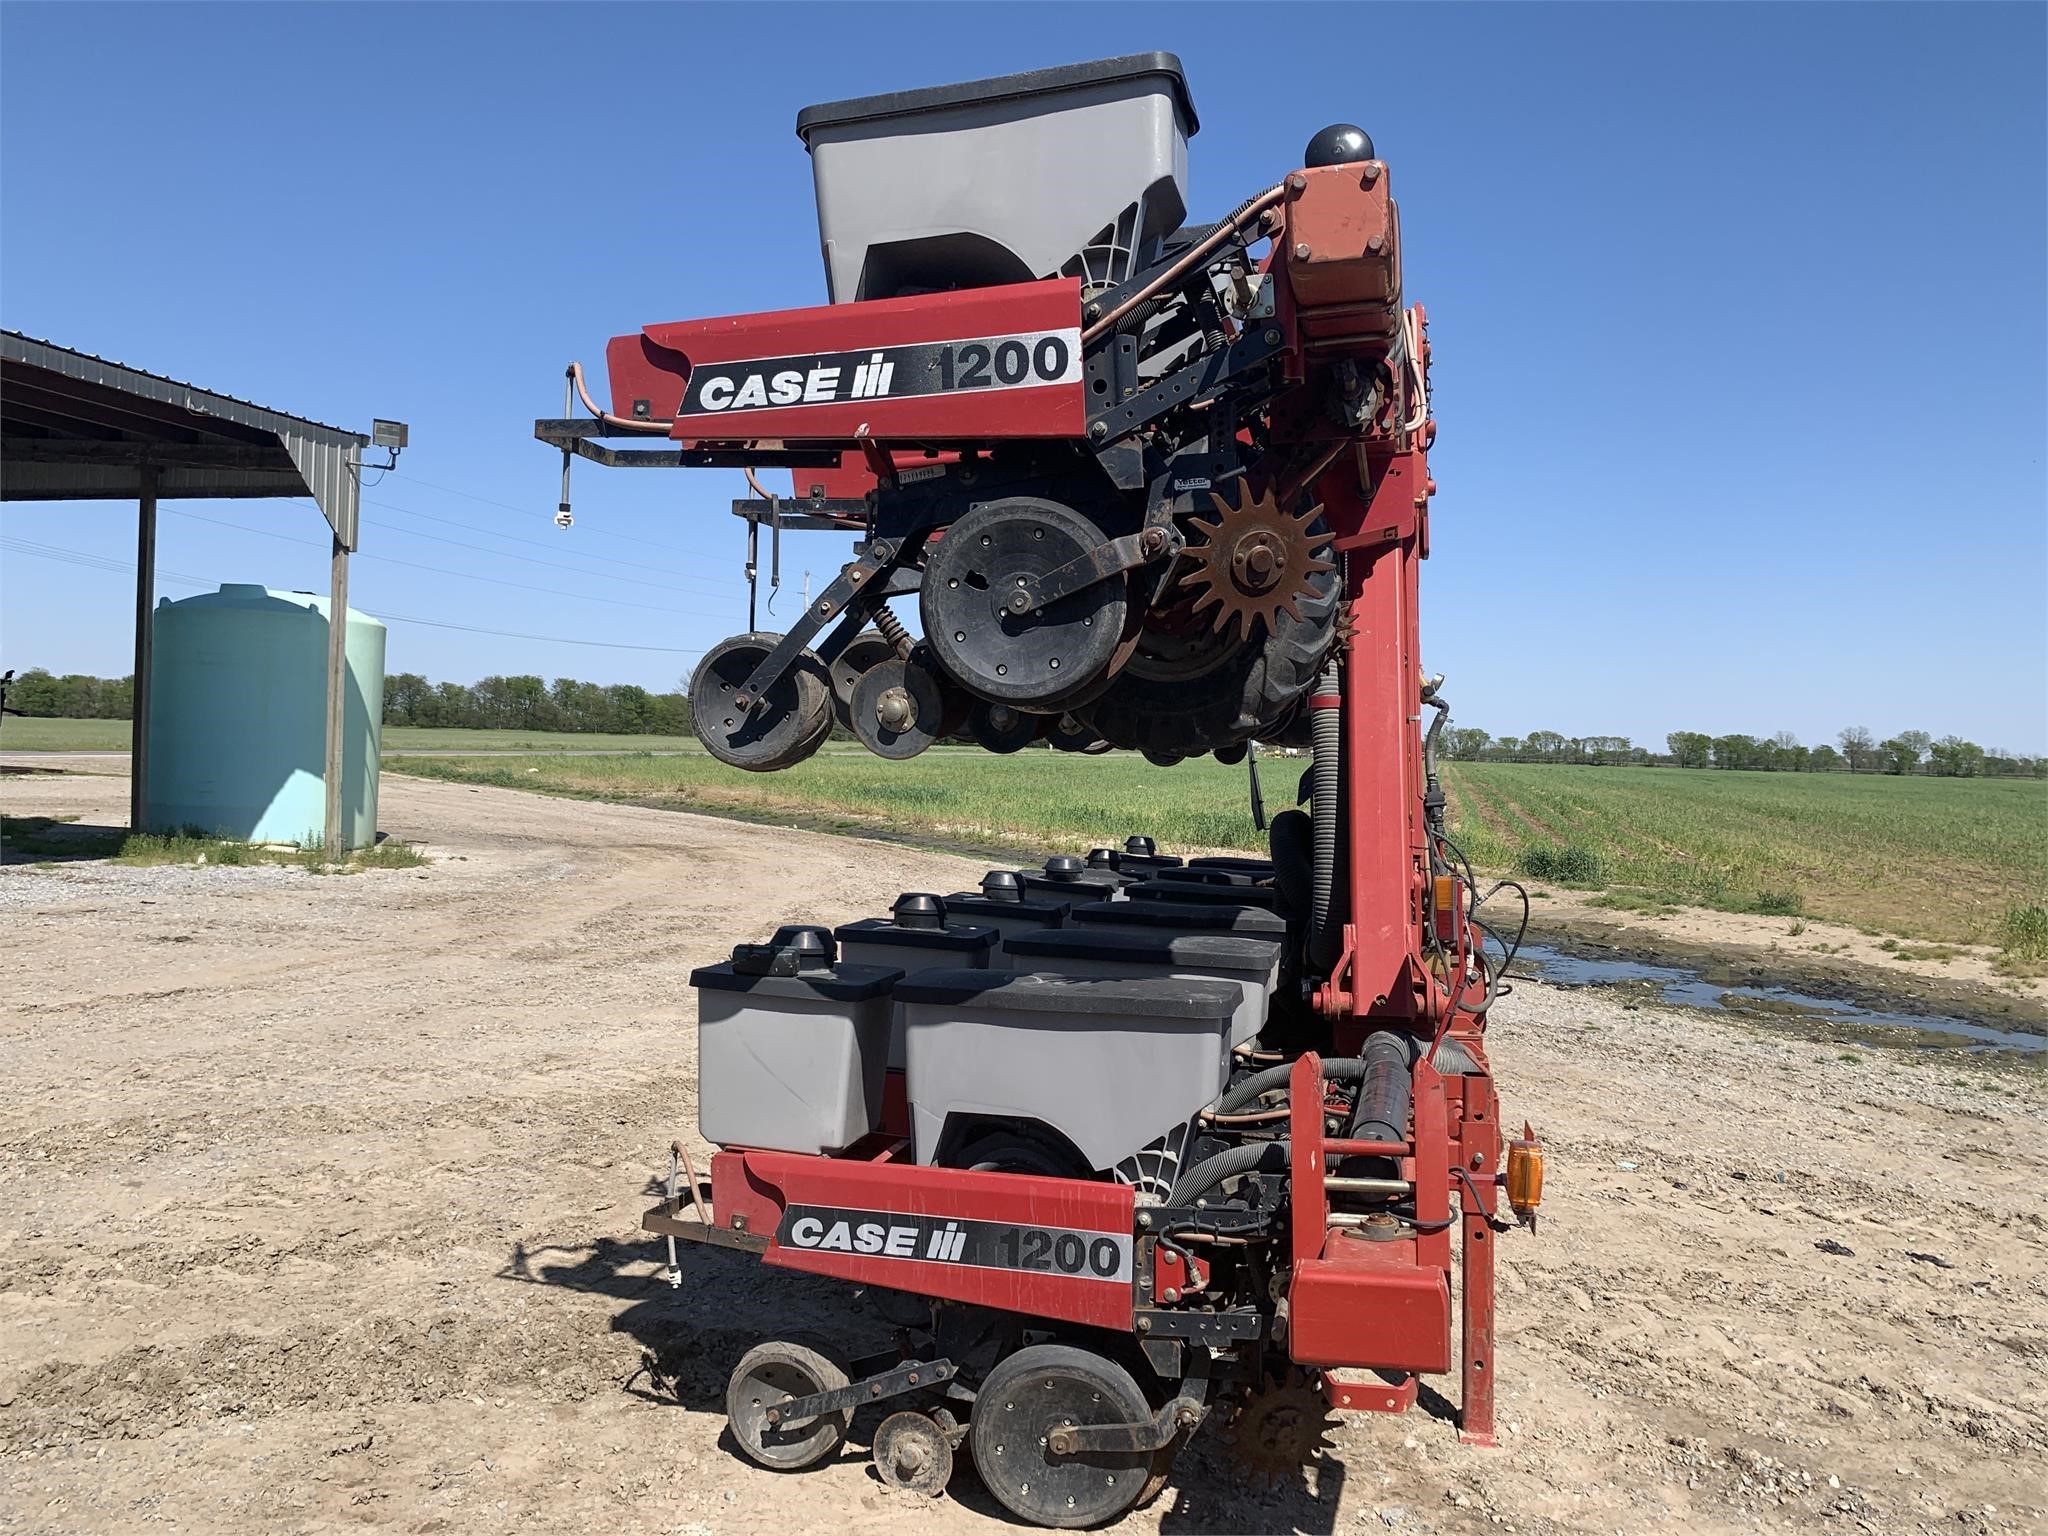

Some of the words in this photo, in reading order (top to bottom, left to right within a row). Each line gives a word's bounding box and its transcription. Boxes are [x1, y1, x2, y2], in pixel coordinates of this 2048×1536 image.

[700, 366, 841, 411] CASE
[937, 336, 1069, 390] 1200
[791, 1217, 919, 1257] CASE
[999, 1228, 1121, 1277] 1200
